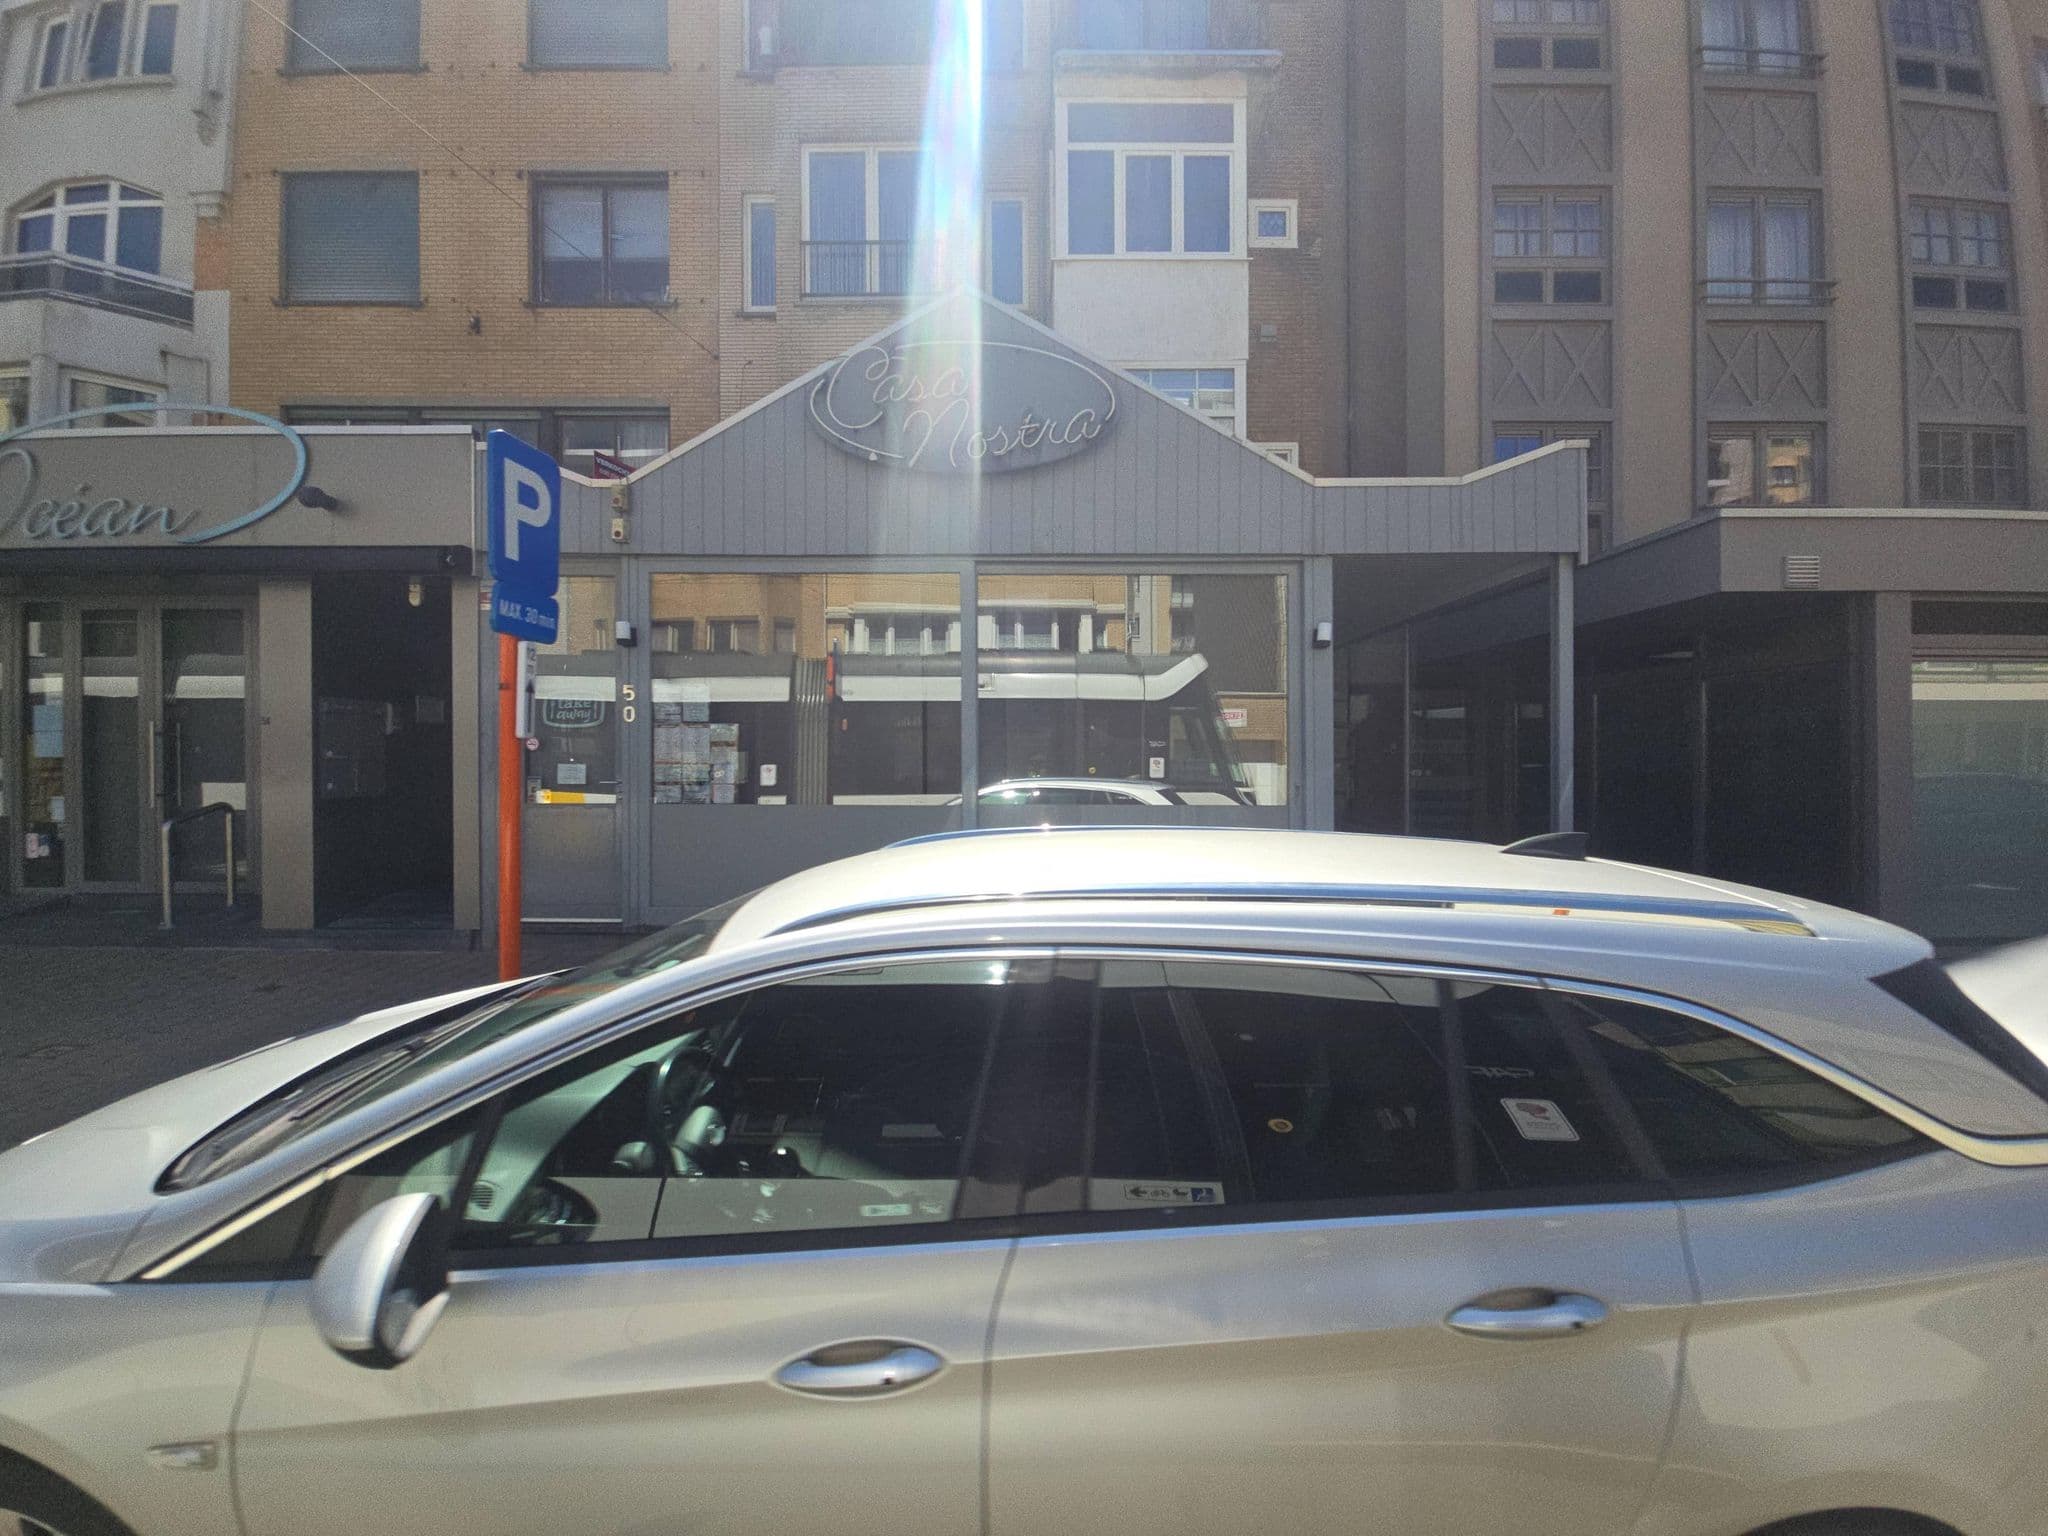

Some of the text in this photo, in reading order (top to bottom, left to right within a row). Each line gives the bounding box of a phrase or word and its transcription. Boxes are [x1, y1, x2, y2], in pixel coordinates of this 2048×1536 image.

[827, 345, 968, 429] Casa
[903, 399, 1105, 468] Nostra
[504, 457, 551, 561] P
[525, 606, 538, 624] 30
[556, 708, 592, 723] away
